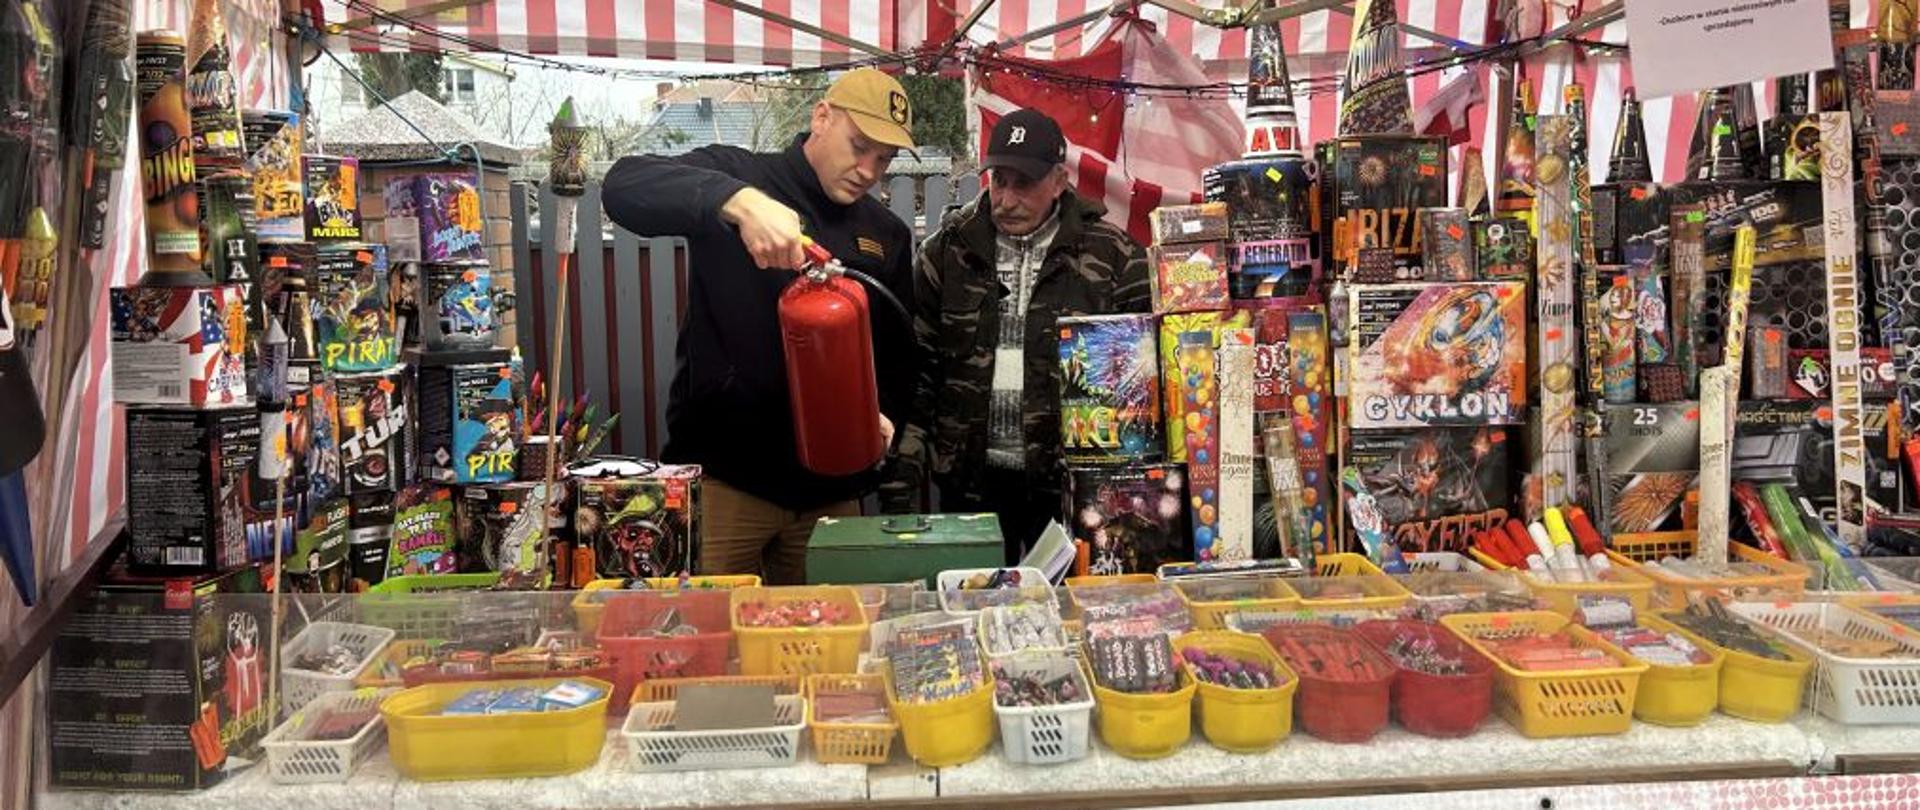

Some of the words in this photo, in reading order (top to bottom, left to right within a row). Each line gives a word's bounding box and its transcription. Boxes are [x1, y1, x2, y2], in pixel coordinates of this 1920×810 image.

[312, 227, 359, 238] MARS
[1832, 254, 1858, 352] OGNIE
[1365, 392, 1508, 421] CYKLON
[1633, 408, 1657, 425] 25
[1836, 364, 1863, 468] ZIMNE
